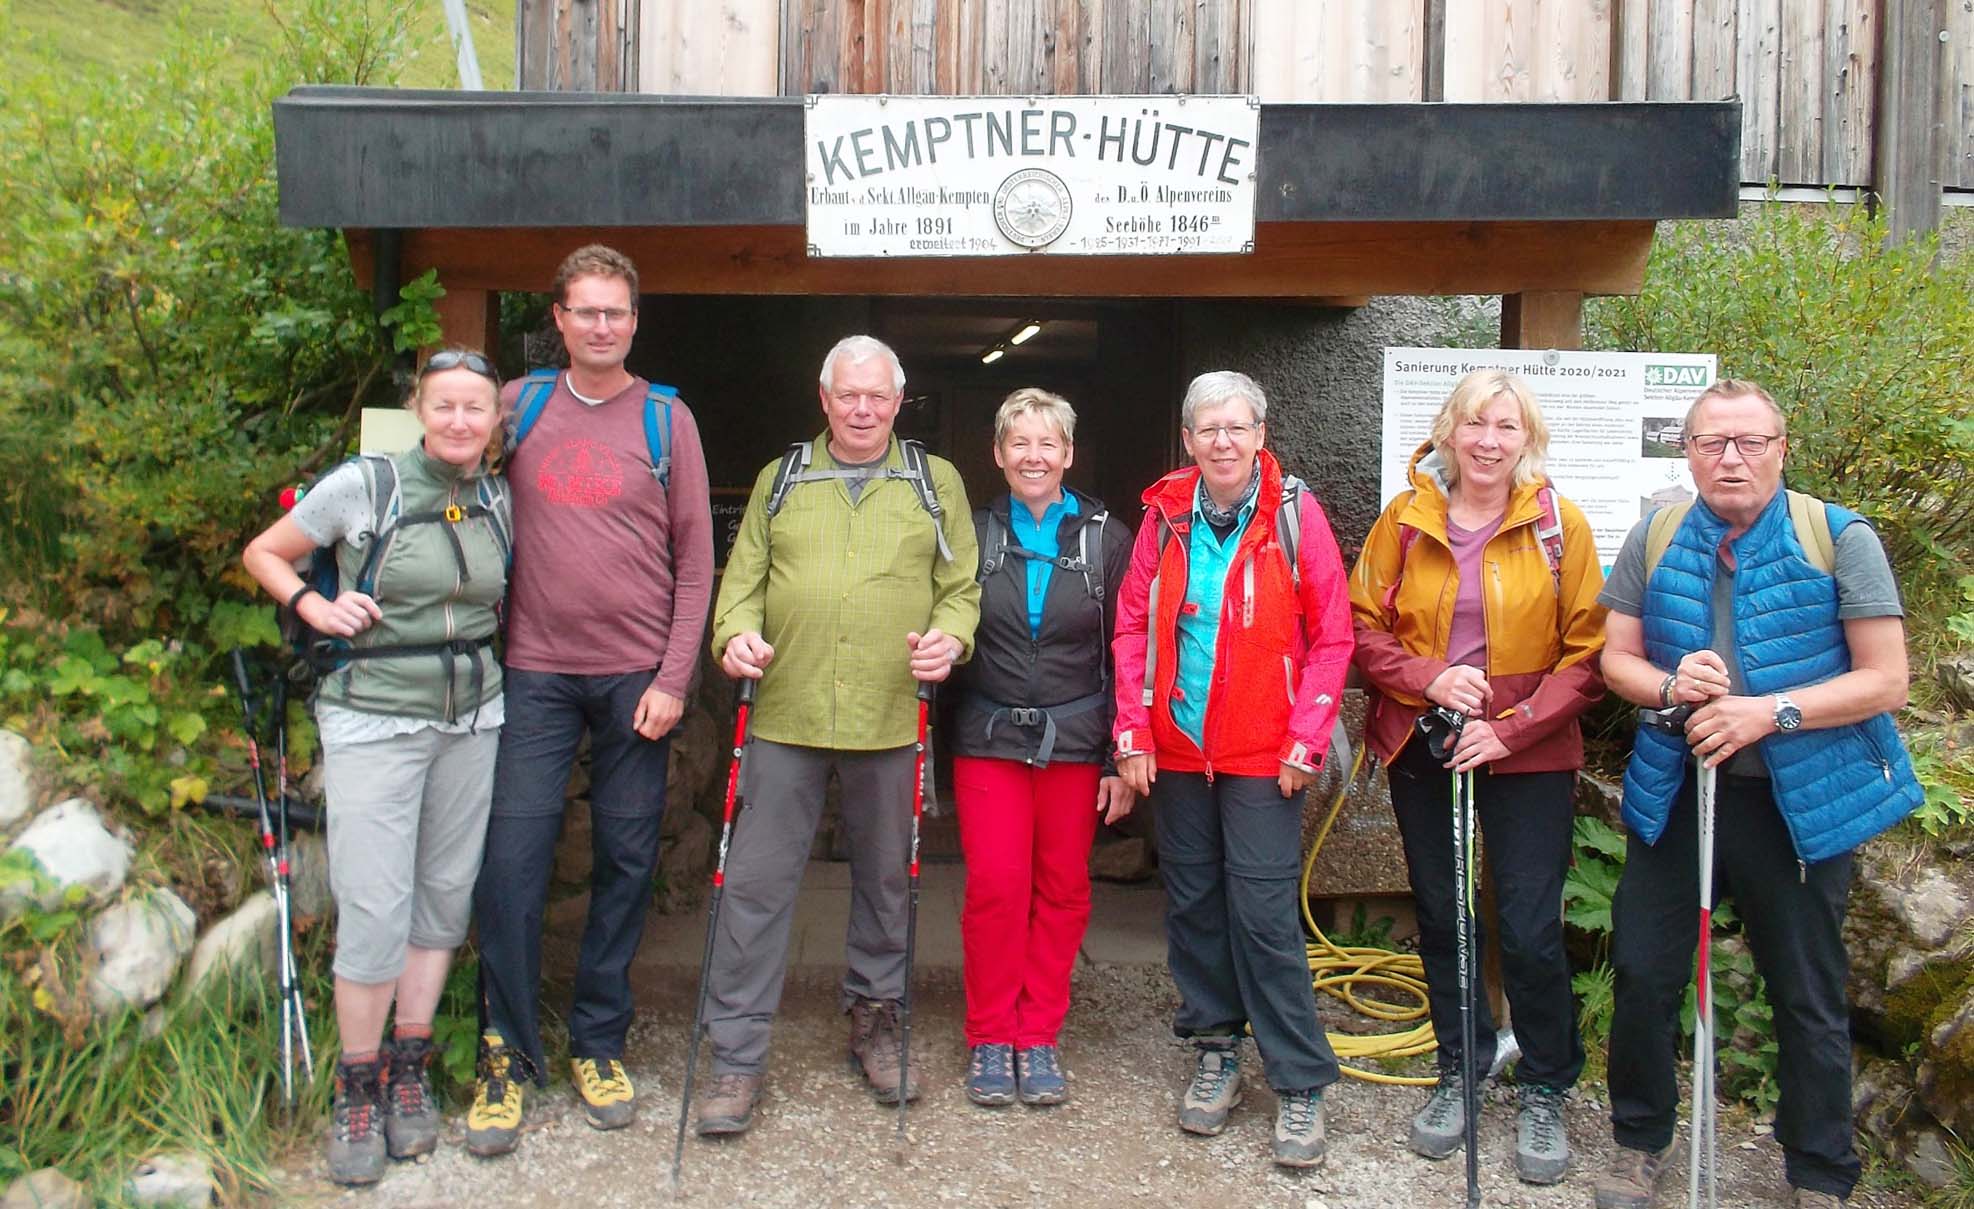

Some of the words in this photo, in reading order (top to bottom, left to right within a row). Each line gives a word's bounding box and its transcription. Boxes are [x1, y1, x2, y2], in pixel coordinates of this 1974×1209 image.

[817, 108, 1250, 186] KEMPTNER-HÜTTE
[811, 187, 849, 205] Erbaut
[1156, 185, 1232, 208] Alpenvereins
[844, 219, 860, 235] im
[869, 218, 907, 235] Jahre
[917, 217, 952, 235] 1891
[1106, 216, 1161, 232] Seehöhe
[1395, 361, 1457, 375] Sanierung
[1523, 364, 1556, 376] Hütte
[1560, 365, 1627, 378] 2020/2021
[1664, 367, 1706, 384] DAV
